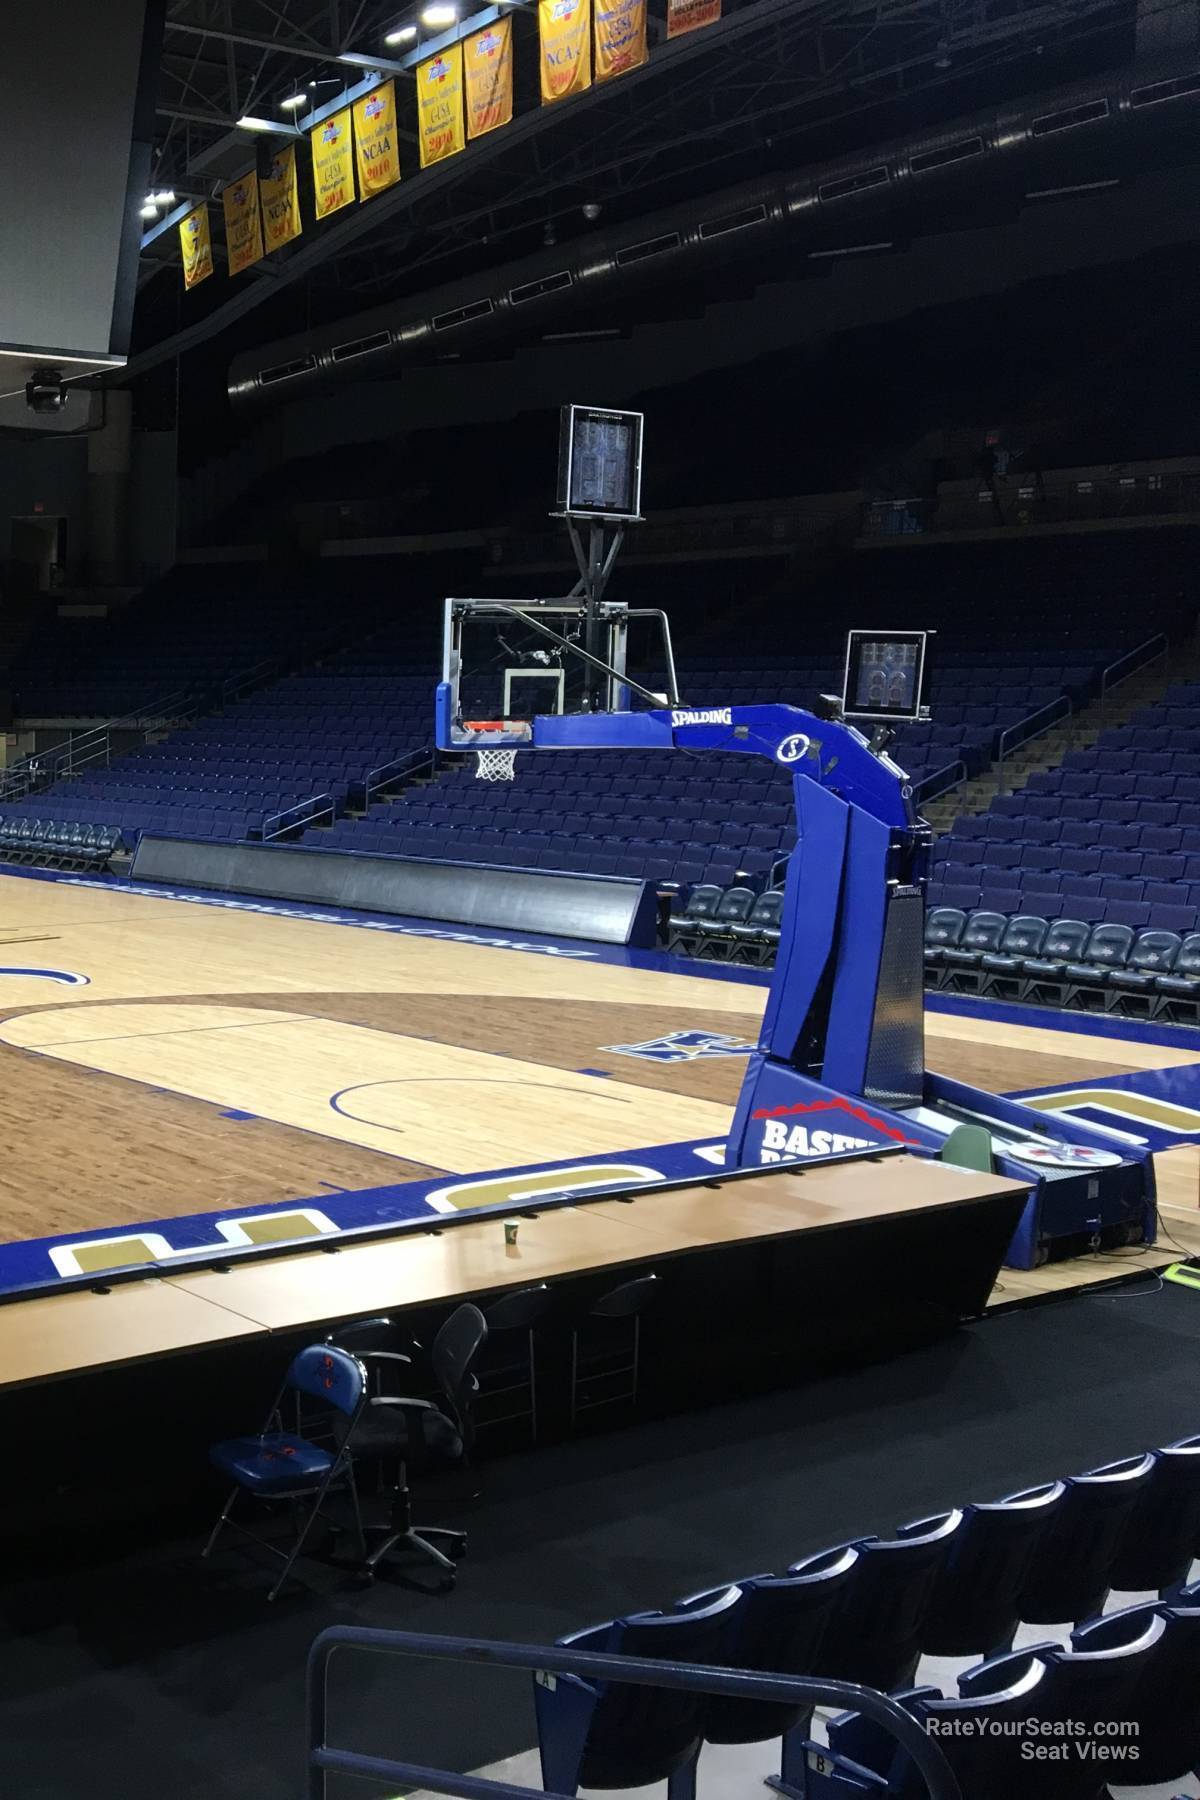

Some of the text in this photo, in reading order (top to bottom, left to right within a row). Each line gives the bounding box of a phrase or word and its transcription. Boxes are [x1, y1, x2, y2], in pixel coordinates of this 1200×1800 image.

[363, 136, 391, 161] NCAA
[671, 707, 733, 728] SPALDING
[816, 1754, 825, 1772] B
